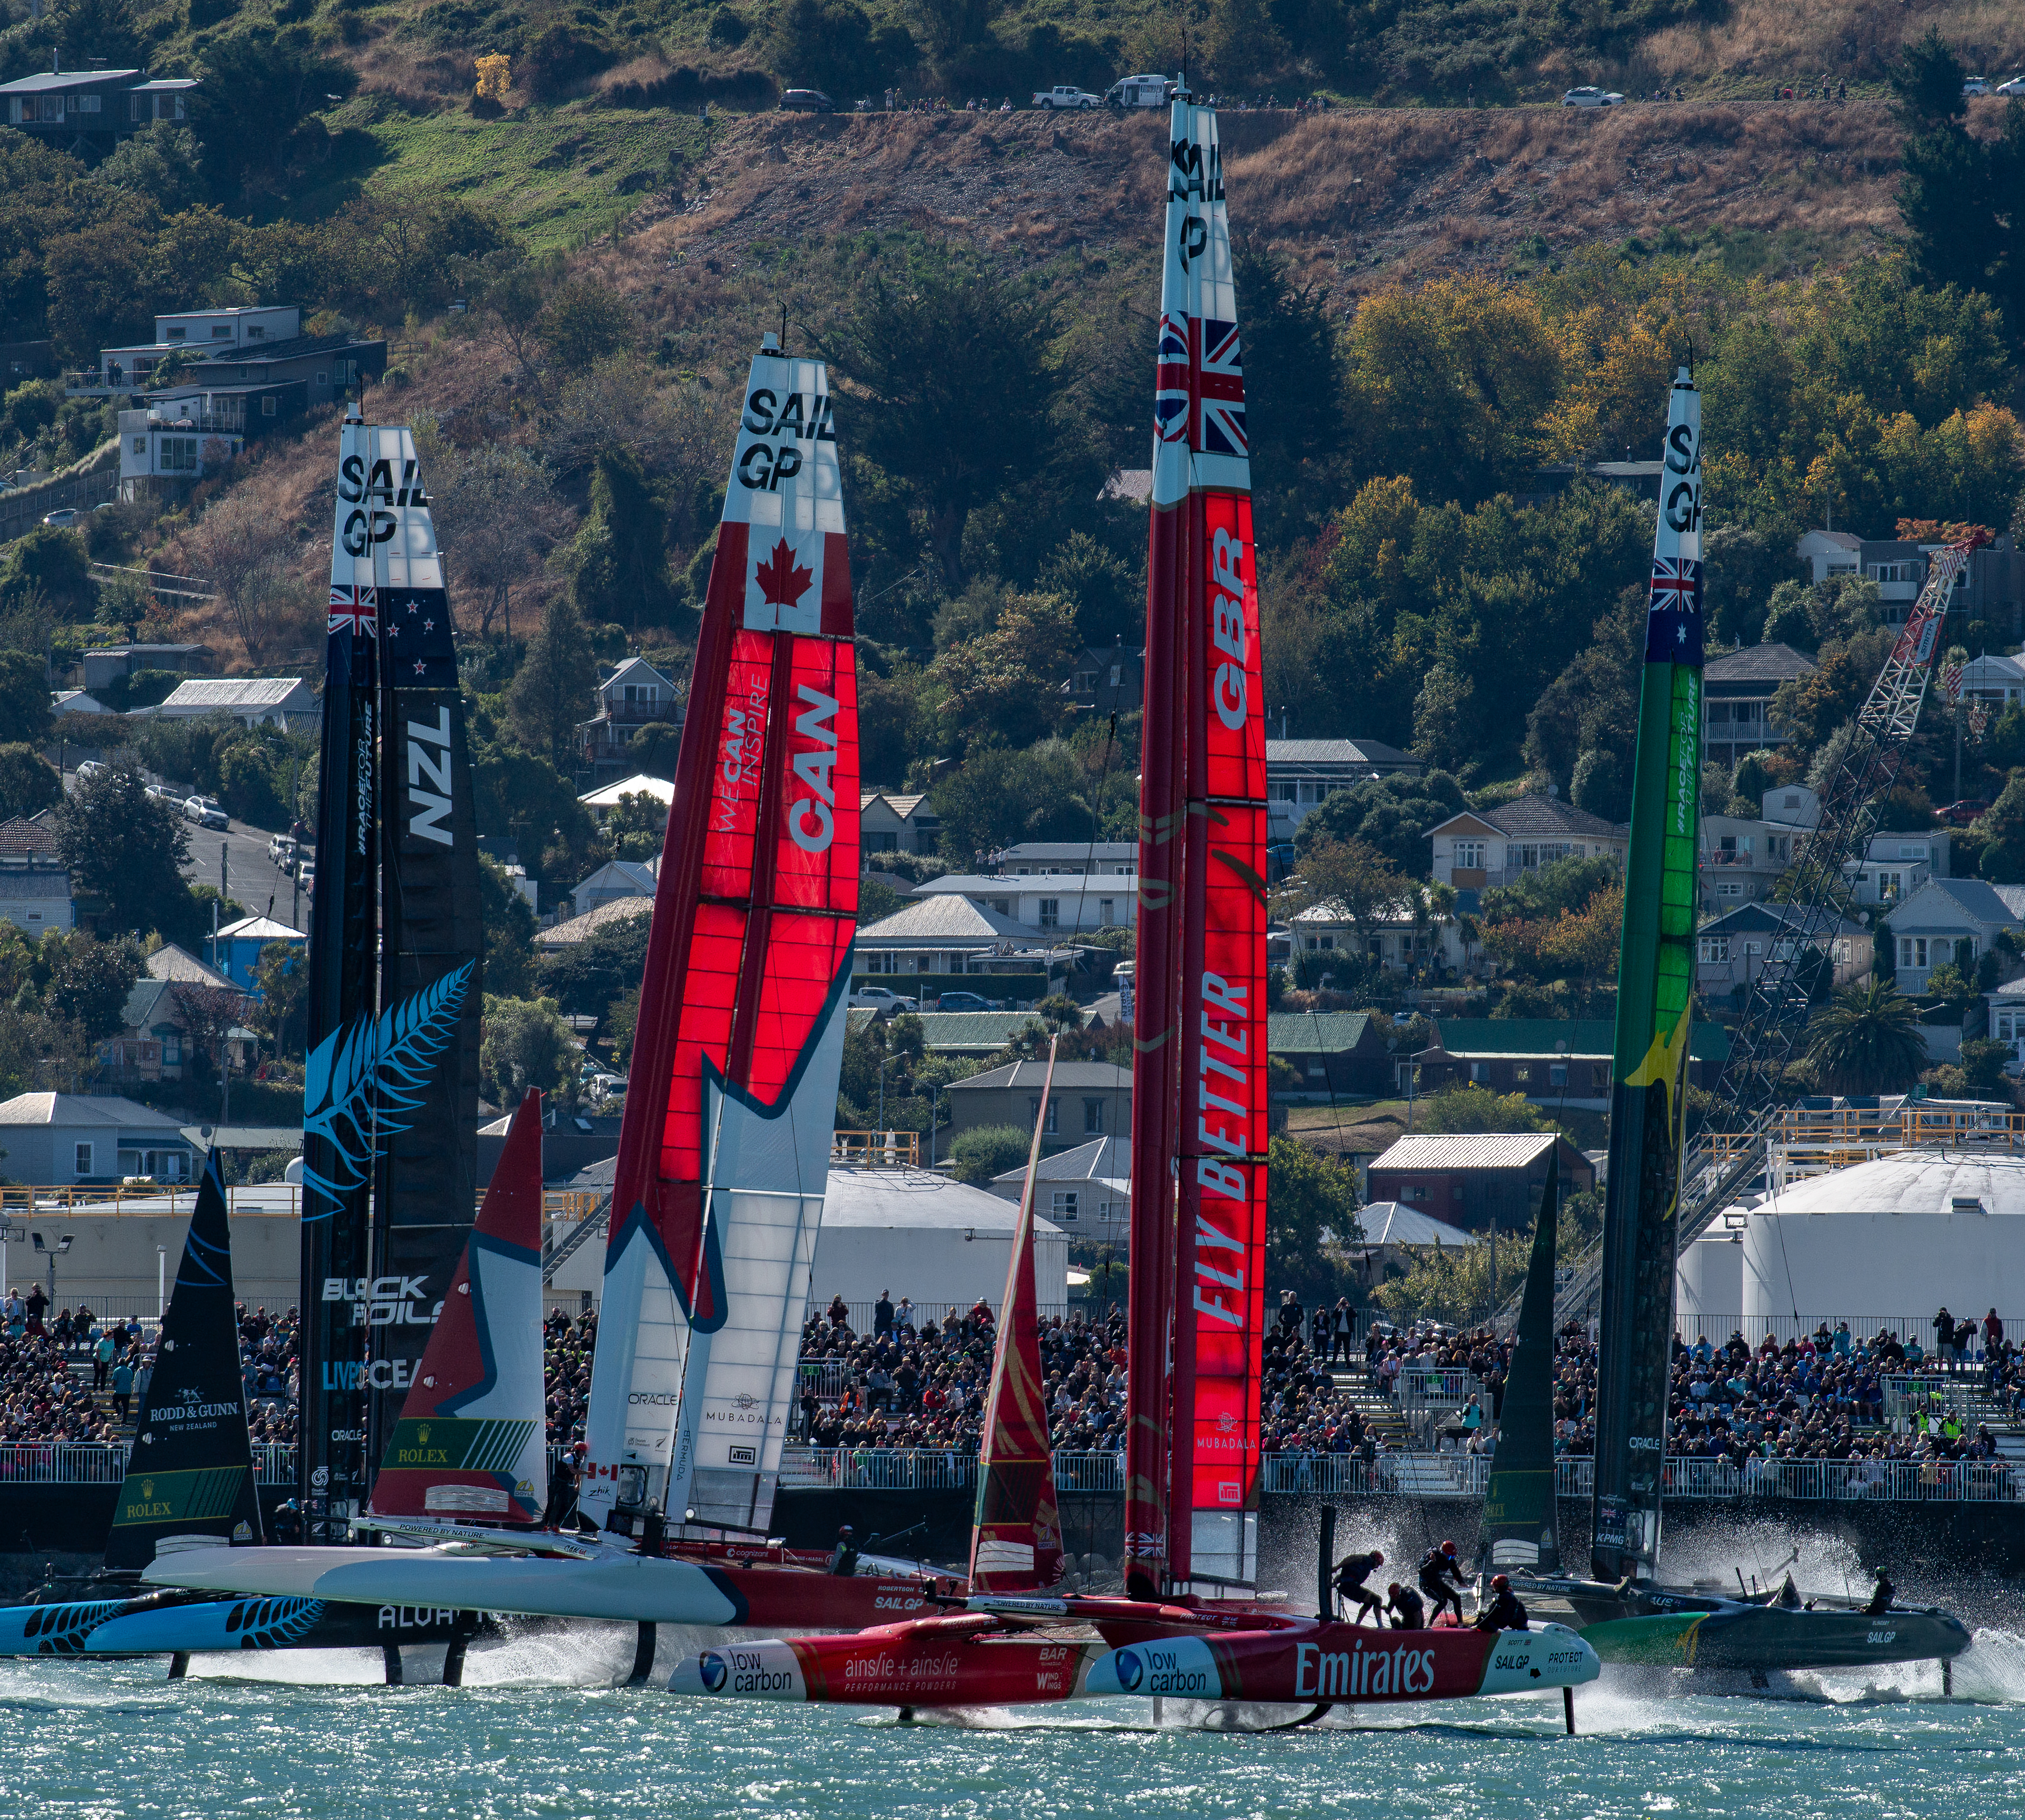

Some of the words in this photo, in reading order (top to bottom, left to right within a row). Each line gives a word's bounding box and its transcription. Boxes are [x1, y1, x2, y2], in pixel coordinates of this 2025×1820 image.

[743, 388, 836, 442] SAIL
[737, 443, 803, 491] GP
[338, 455, 429, 507] SAIL
[341, 509, 397, 558] GP
[1213, 527, 1247, 730] GBR
[742, 673, 767, 786] INSPIRE
[724, 708, 745, 783] CAN
[408, 706, 453, 846] NZL
[789, 684, 839, 853] CAN
[719, 786, 739, 832] WE
[1198, 971, 1247, 1202] BETTER
[1193, 1214, 1244, 1328] FLY
[322, 1275, 429, 1301] BLACK
[323, 1361, 355, 1390] LIVE
[355, 1359, 422, 1390] OCE
[150, 1406, 185, 1421] RODD
[187, 1406, 197, 1418] &
[199, 1402, 237, 1416] GUNN
[628, 1393, 678, 1405] ORACLE
[187, 1421, 217, 1430] ZEALAND
[706, 1412, 782, 1425] MUBADALA
[332, 1429, 362, 1441] ORACLE
[1197, 1438, 1256, 1449] MUBADALA
[1629, 1437, 1659, 1450] ORACLE
[398, 1449, 448, 1462] ROLEX
[677, 1430, 690, 1481] BERMUDA
[588, 1486, 611, 1496] zhik
[127, 1502, 172, 1518] ROLEX
[400, 1524, 439, 1534] POWERED
[1596, 1533, 1624, 1544] KPMG
[1546, 1583, 1571, 1592] NATURE
[728, 1649, 761, 1671] low
[846, 1651, 894, 1677] ainslie
[898, 1660, 905, 1674] +
[911, 1650, 959, 1675] ainslie
[1039, 1647, 1067, 1661] BAR
[1145, 1648, 1176, 1670] low
[1549, 1651, 1583, 1664] PROTECT
[735, 1667, 792, 1692] carbon
[1150, 1667, 1206, 1692] carbon
[1295, 1639, 1435, 1697] Emirates
[845, 1682, 910, 1692] PERFORMANCE
[915, 1681, 956, 1691] POWDERS
